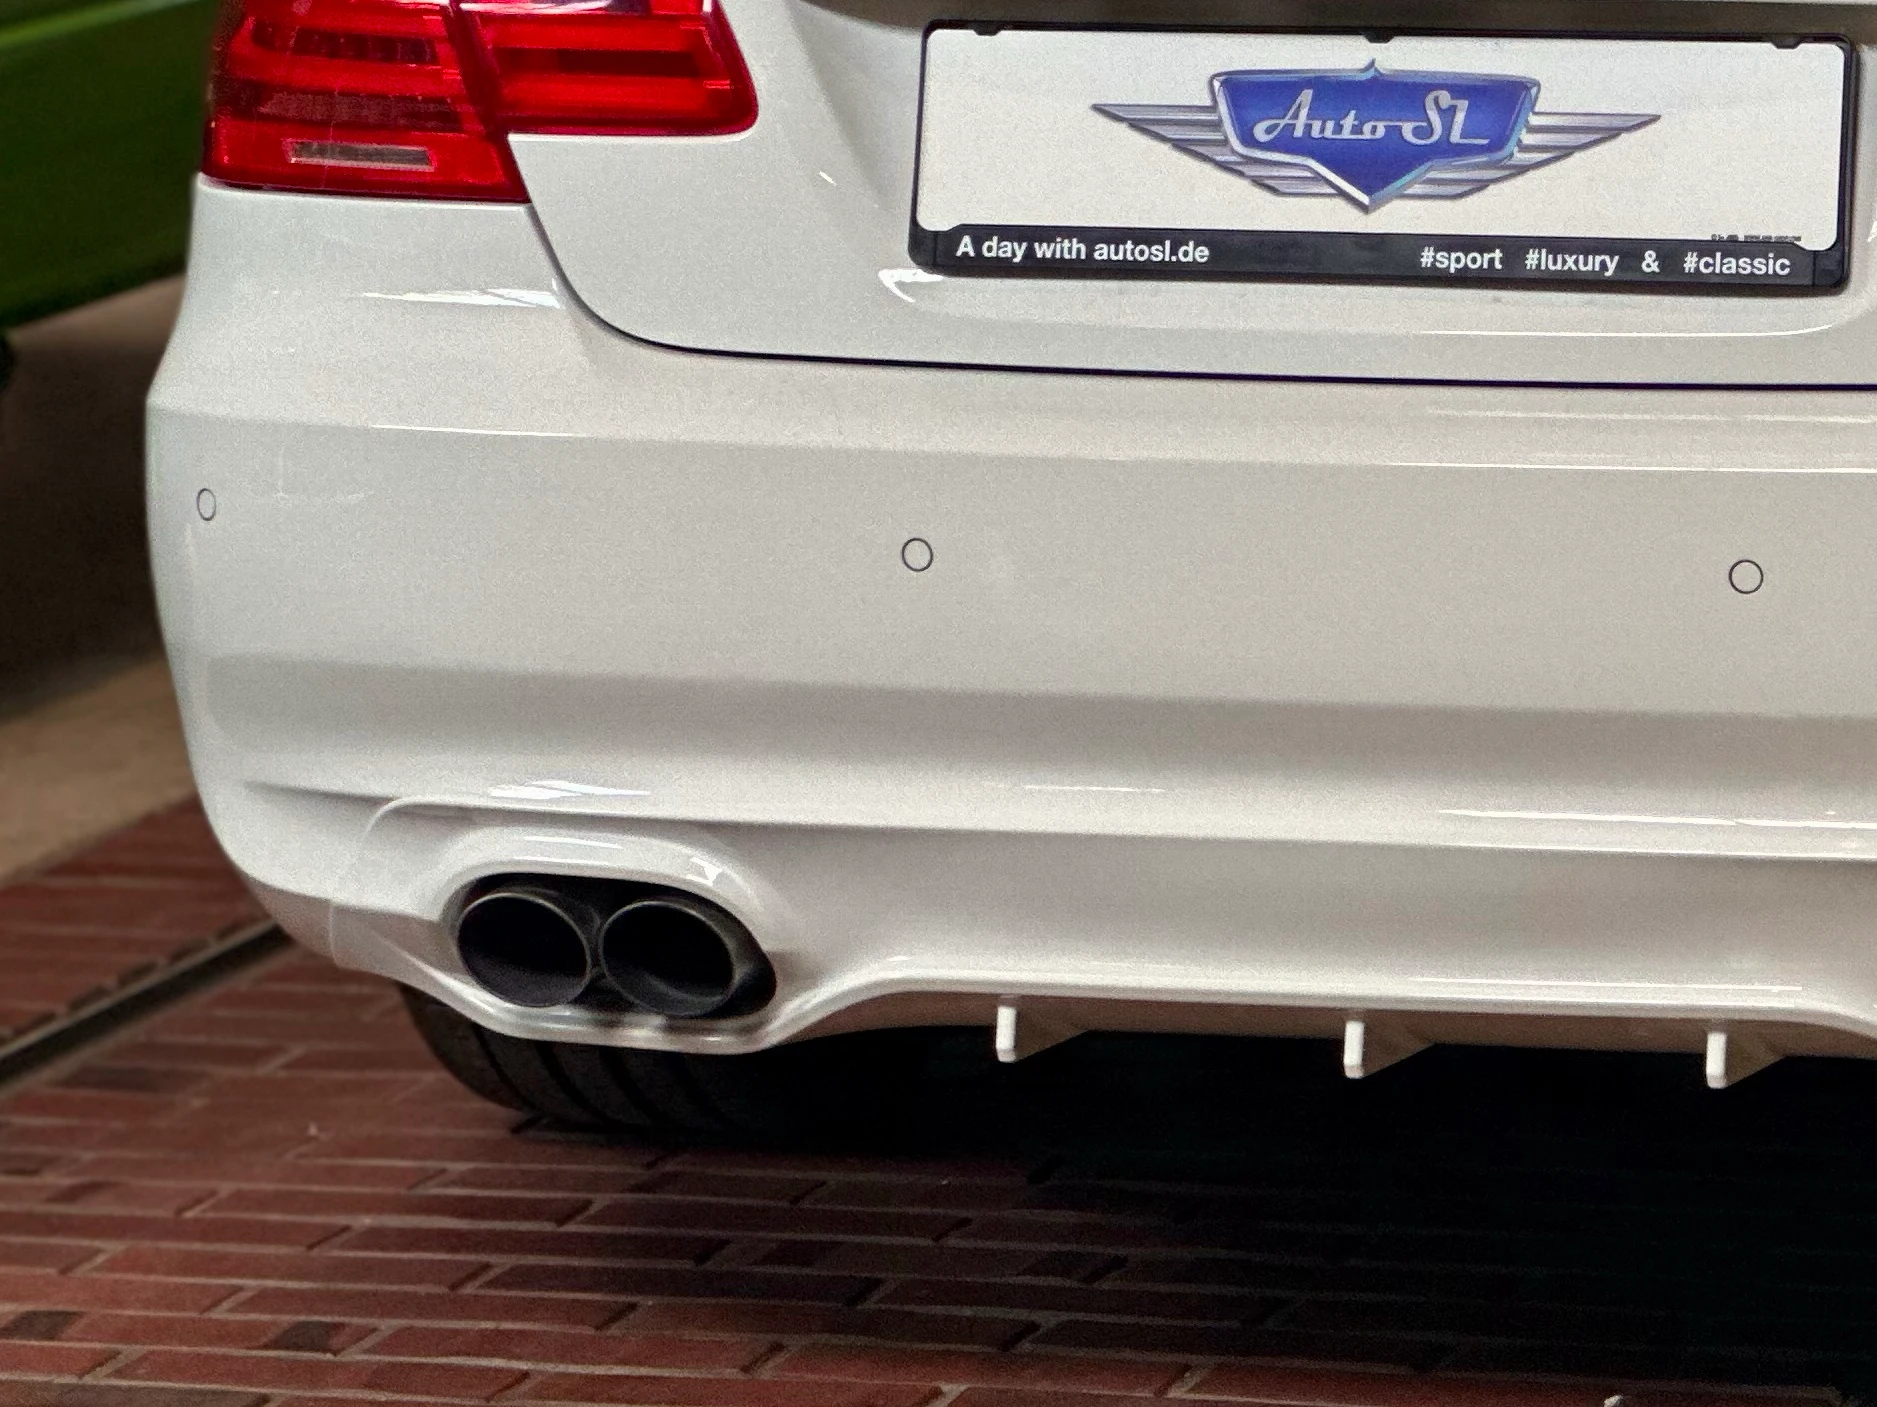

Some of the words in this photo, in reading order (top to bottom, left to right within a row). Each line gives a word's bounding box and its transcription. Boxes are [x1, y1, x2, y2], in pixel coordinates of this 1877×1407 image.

[1254, 89, 1394, 143] Auto
[1404, 90, 1491, 146] SL
[956, 236, 975, 258] A
[981, 238, 1027, 264] day
[1033, 238, 1087, 261] with
[1093, 240, 1211, 264] autosl.de
[1419, 247, 1503, 273] #sport
[1524, 249, 1620, 277] #luxury
[1640, 251, 1662, 274] &
[1683, 251, 1792, 276] #classic
